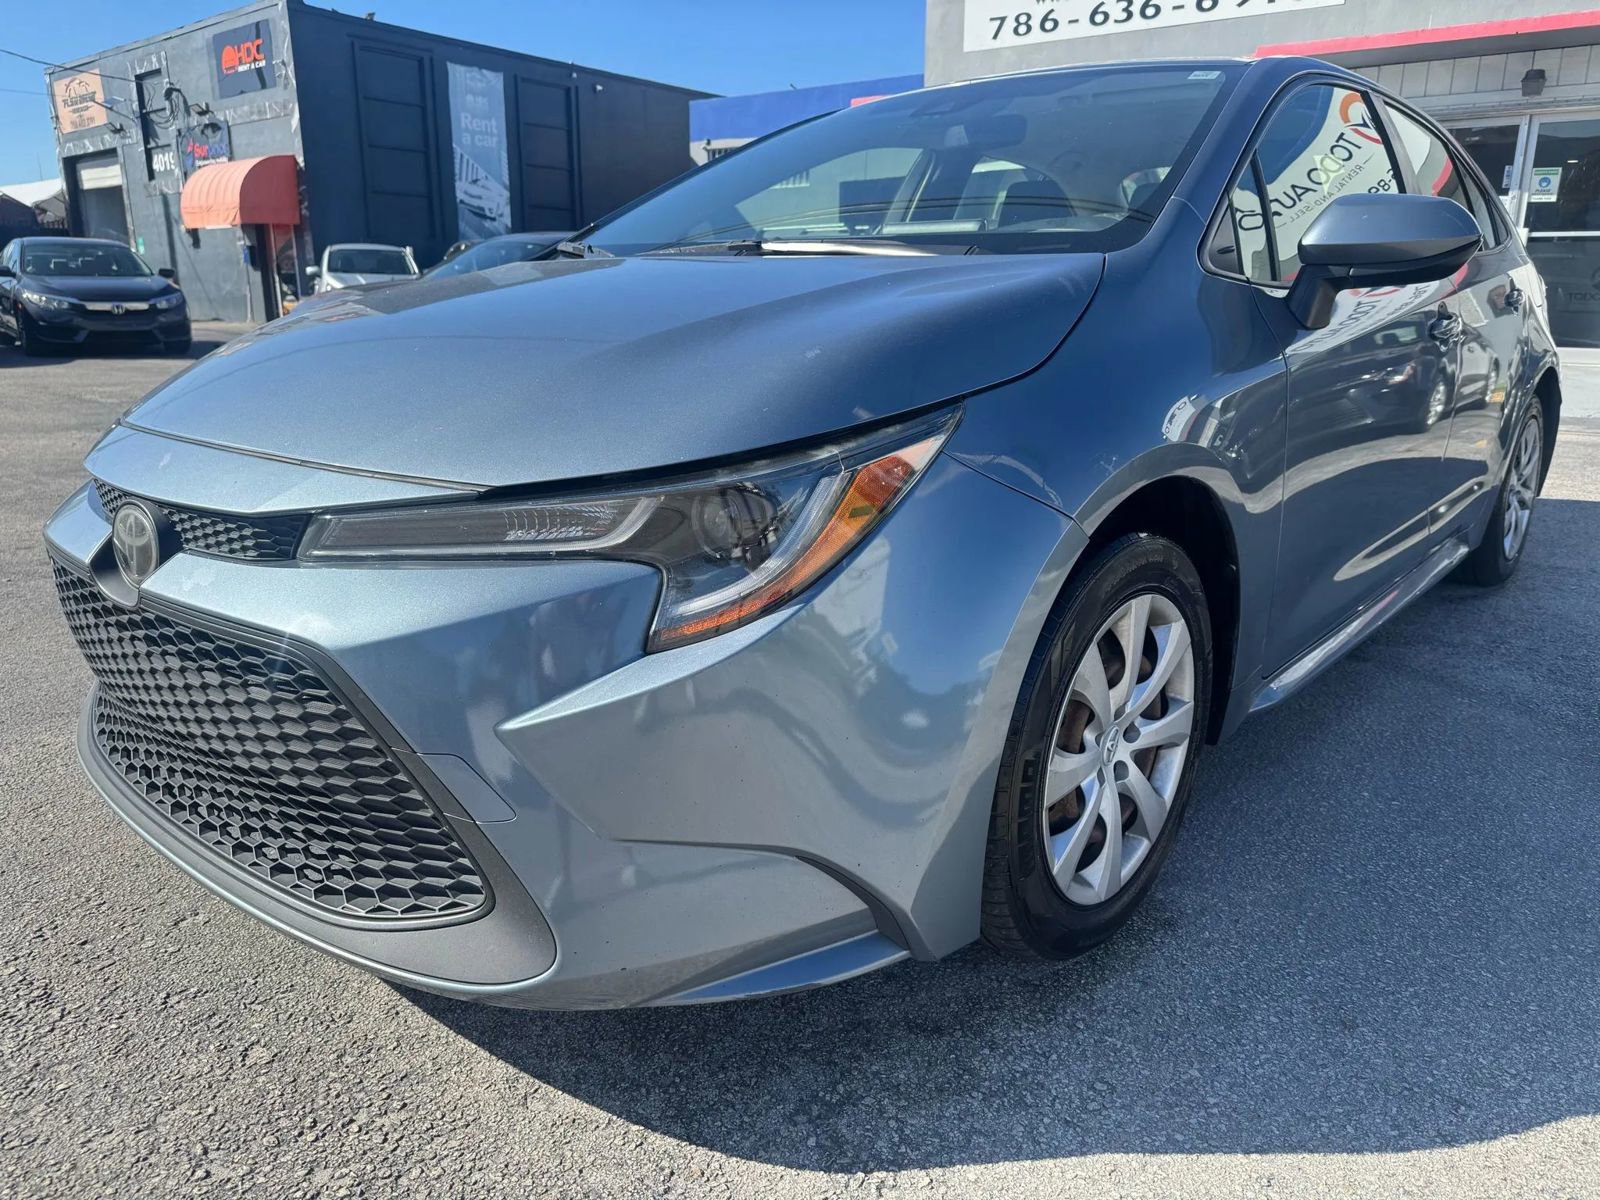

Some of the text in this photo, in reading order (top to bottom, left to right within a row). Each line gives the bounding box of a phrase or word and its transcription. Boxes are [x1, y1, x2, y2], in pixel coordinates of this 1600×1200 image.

[236, 38, 265, 65] HDC
[460, 112, 497, 135] Rent
[462, 132, 498, 147] a car
